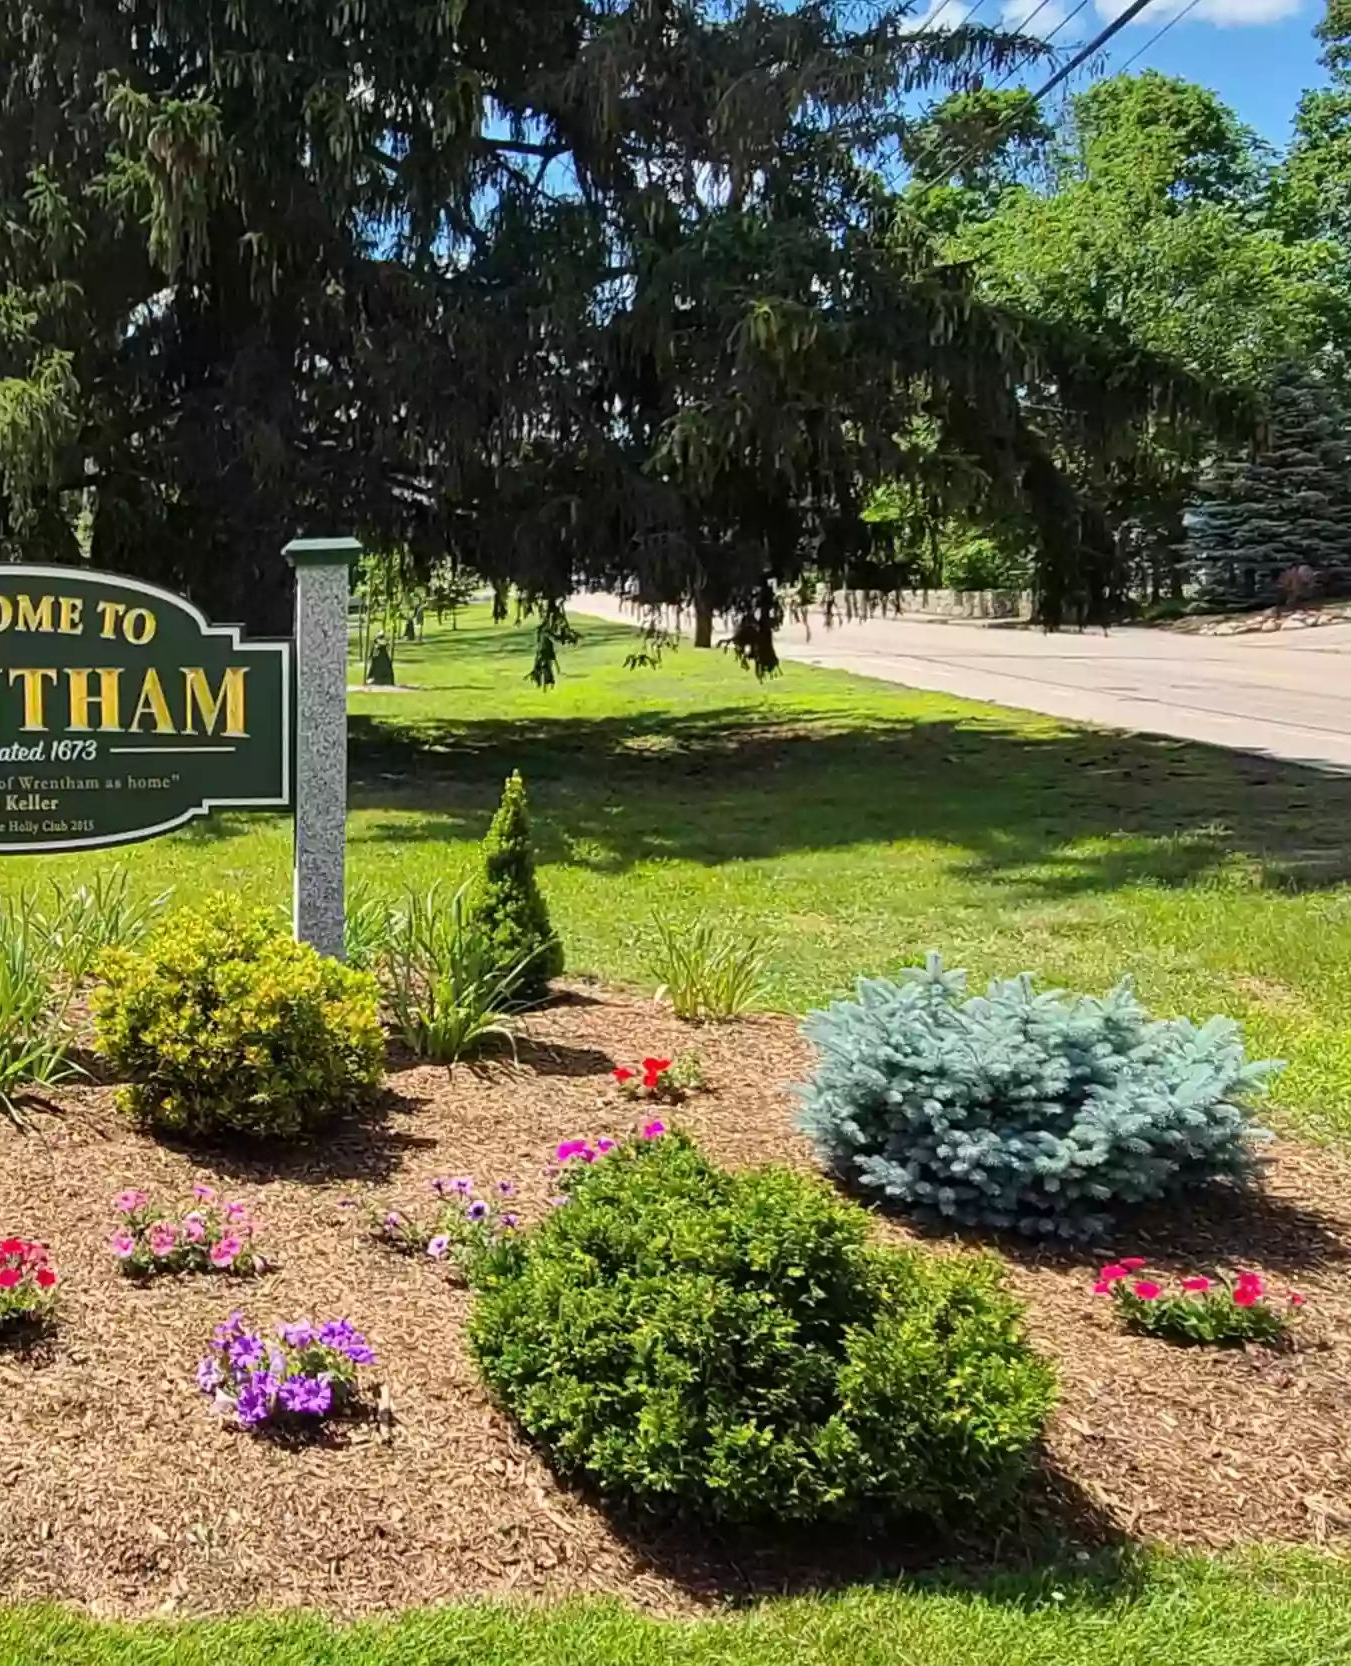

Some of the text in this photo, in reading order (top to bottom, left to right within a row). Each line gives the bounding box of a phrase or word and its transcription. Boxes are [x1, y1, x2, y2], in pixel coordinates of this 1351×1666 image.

[98, 600, 157, 645] TO
[50, 739, 97, 761] 1673
[18, 775, 100, 790] Wrentham
[105, 778, 122, 789] as
[127, 773, 180, 789] home"
[5, 793, 59, 811] Keller
[8, 820, 39, 835] Holly
[42, 819, 68, 832] Club
[70, 819, 95, 832] 2015
